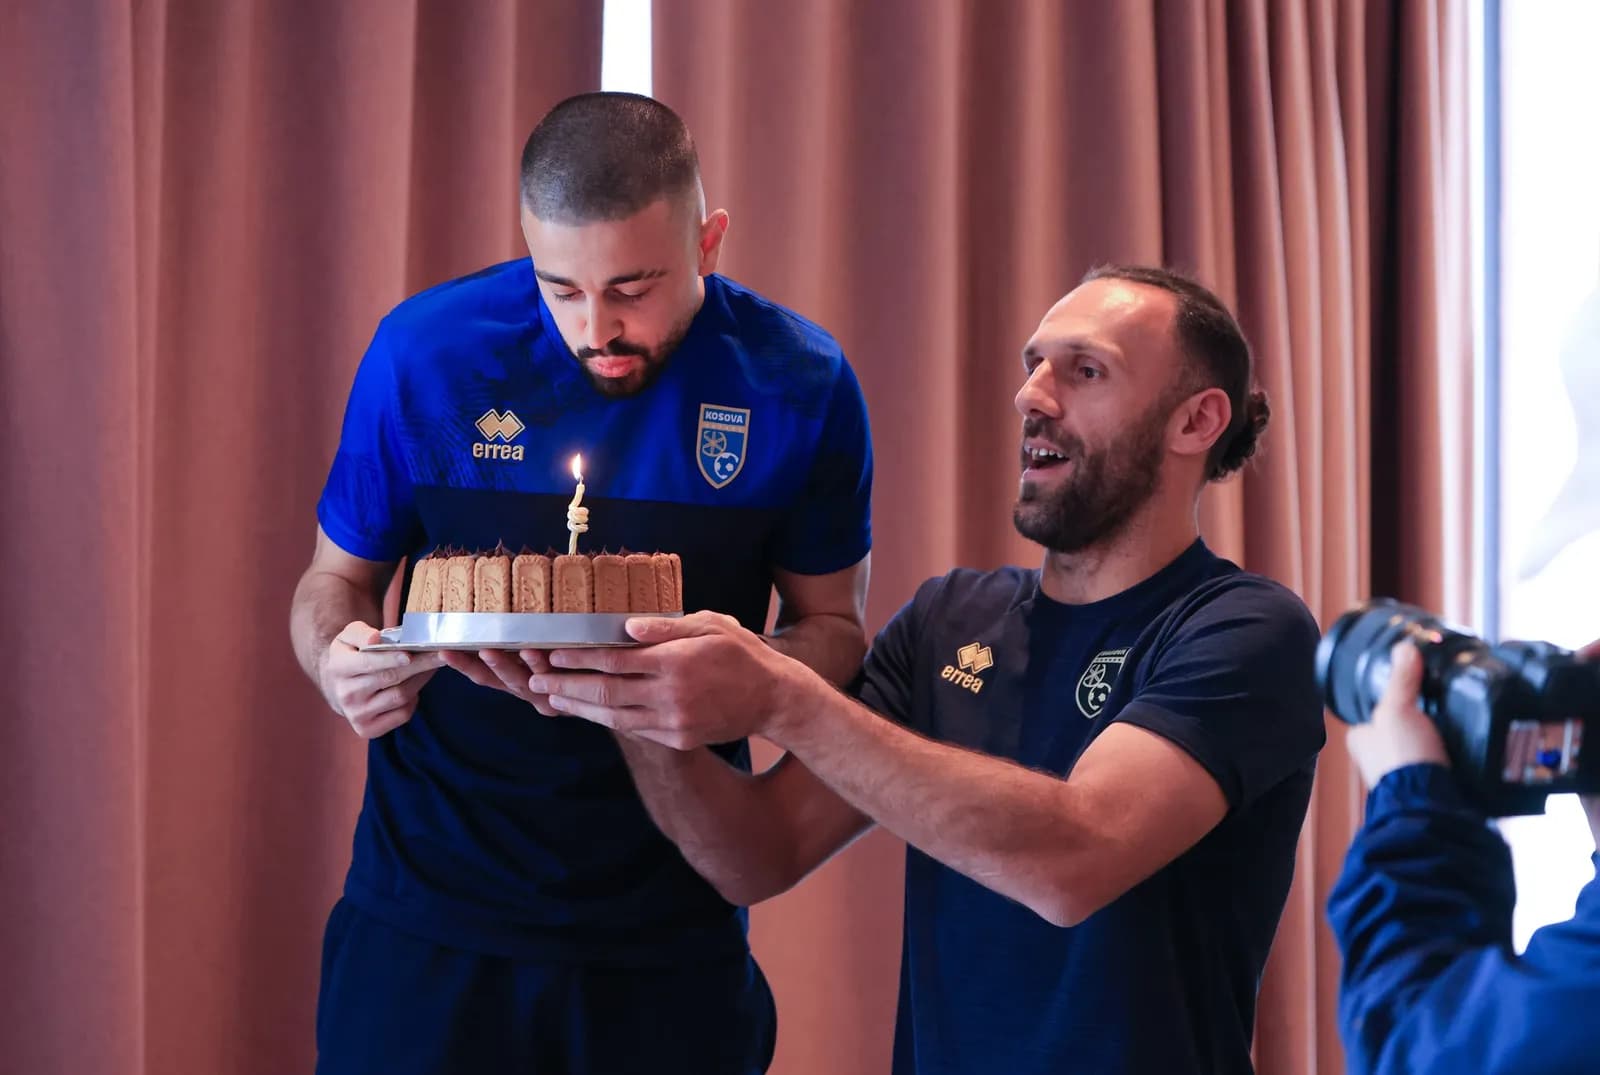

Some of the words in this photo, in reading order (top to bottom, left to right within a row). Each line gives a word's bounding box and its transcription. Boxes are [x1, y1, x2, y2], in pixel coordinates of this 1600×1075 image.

[705, 410, 744, 424] KOSOVA
[472, 442, 525, 461] errea
[941, 665, 984, 694] errea
